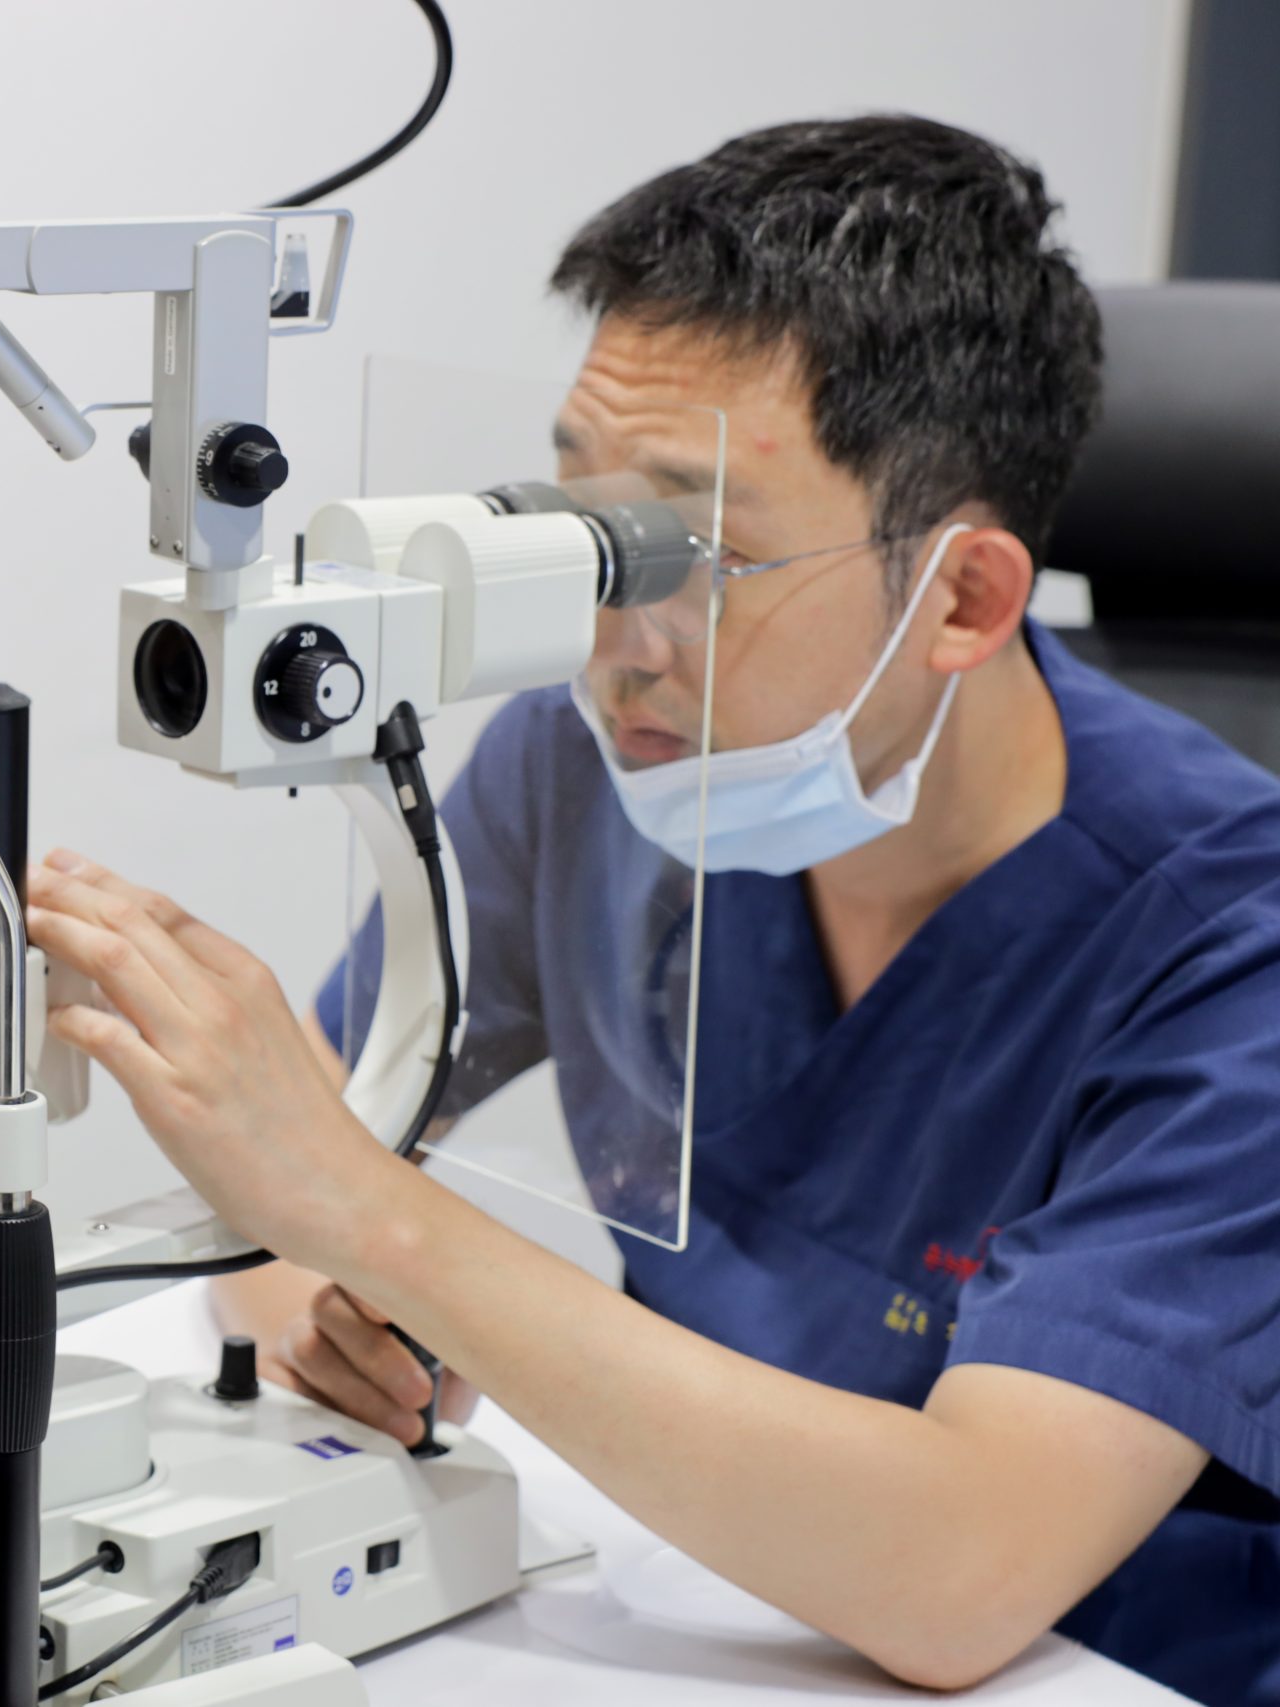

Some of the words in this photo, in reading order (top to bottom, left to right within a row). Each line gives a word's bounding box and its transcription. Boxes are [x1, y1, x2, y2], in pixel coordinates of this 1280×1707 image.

[300, 630, 317, 647] 20
[263, 679, 279, 696] 12
[301, 721, 311, 737] 8
